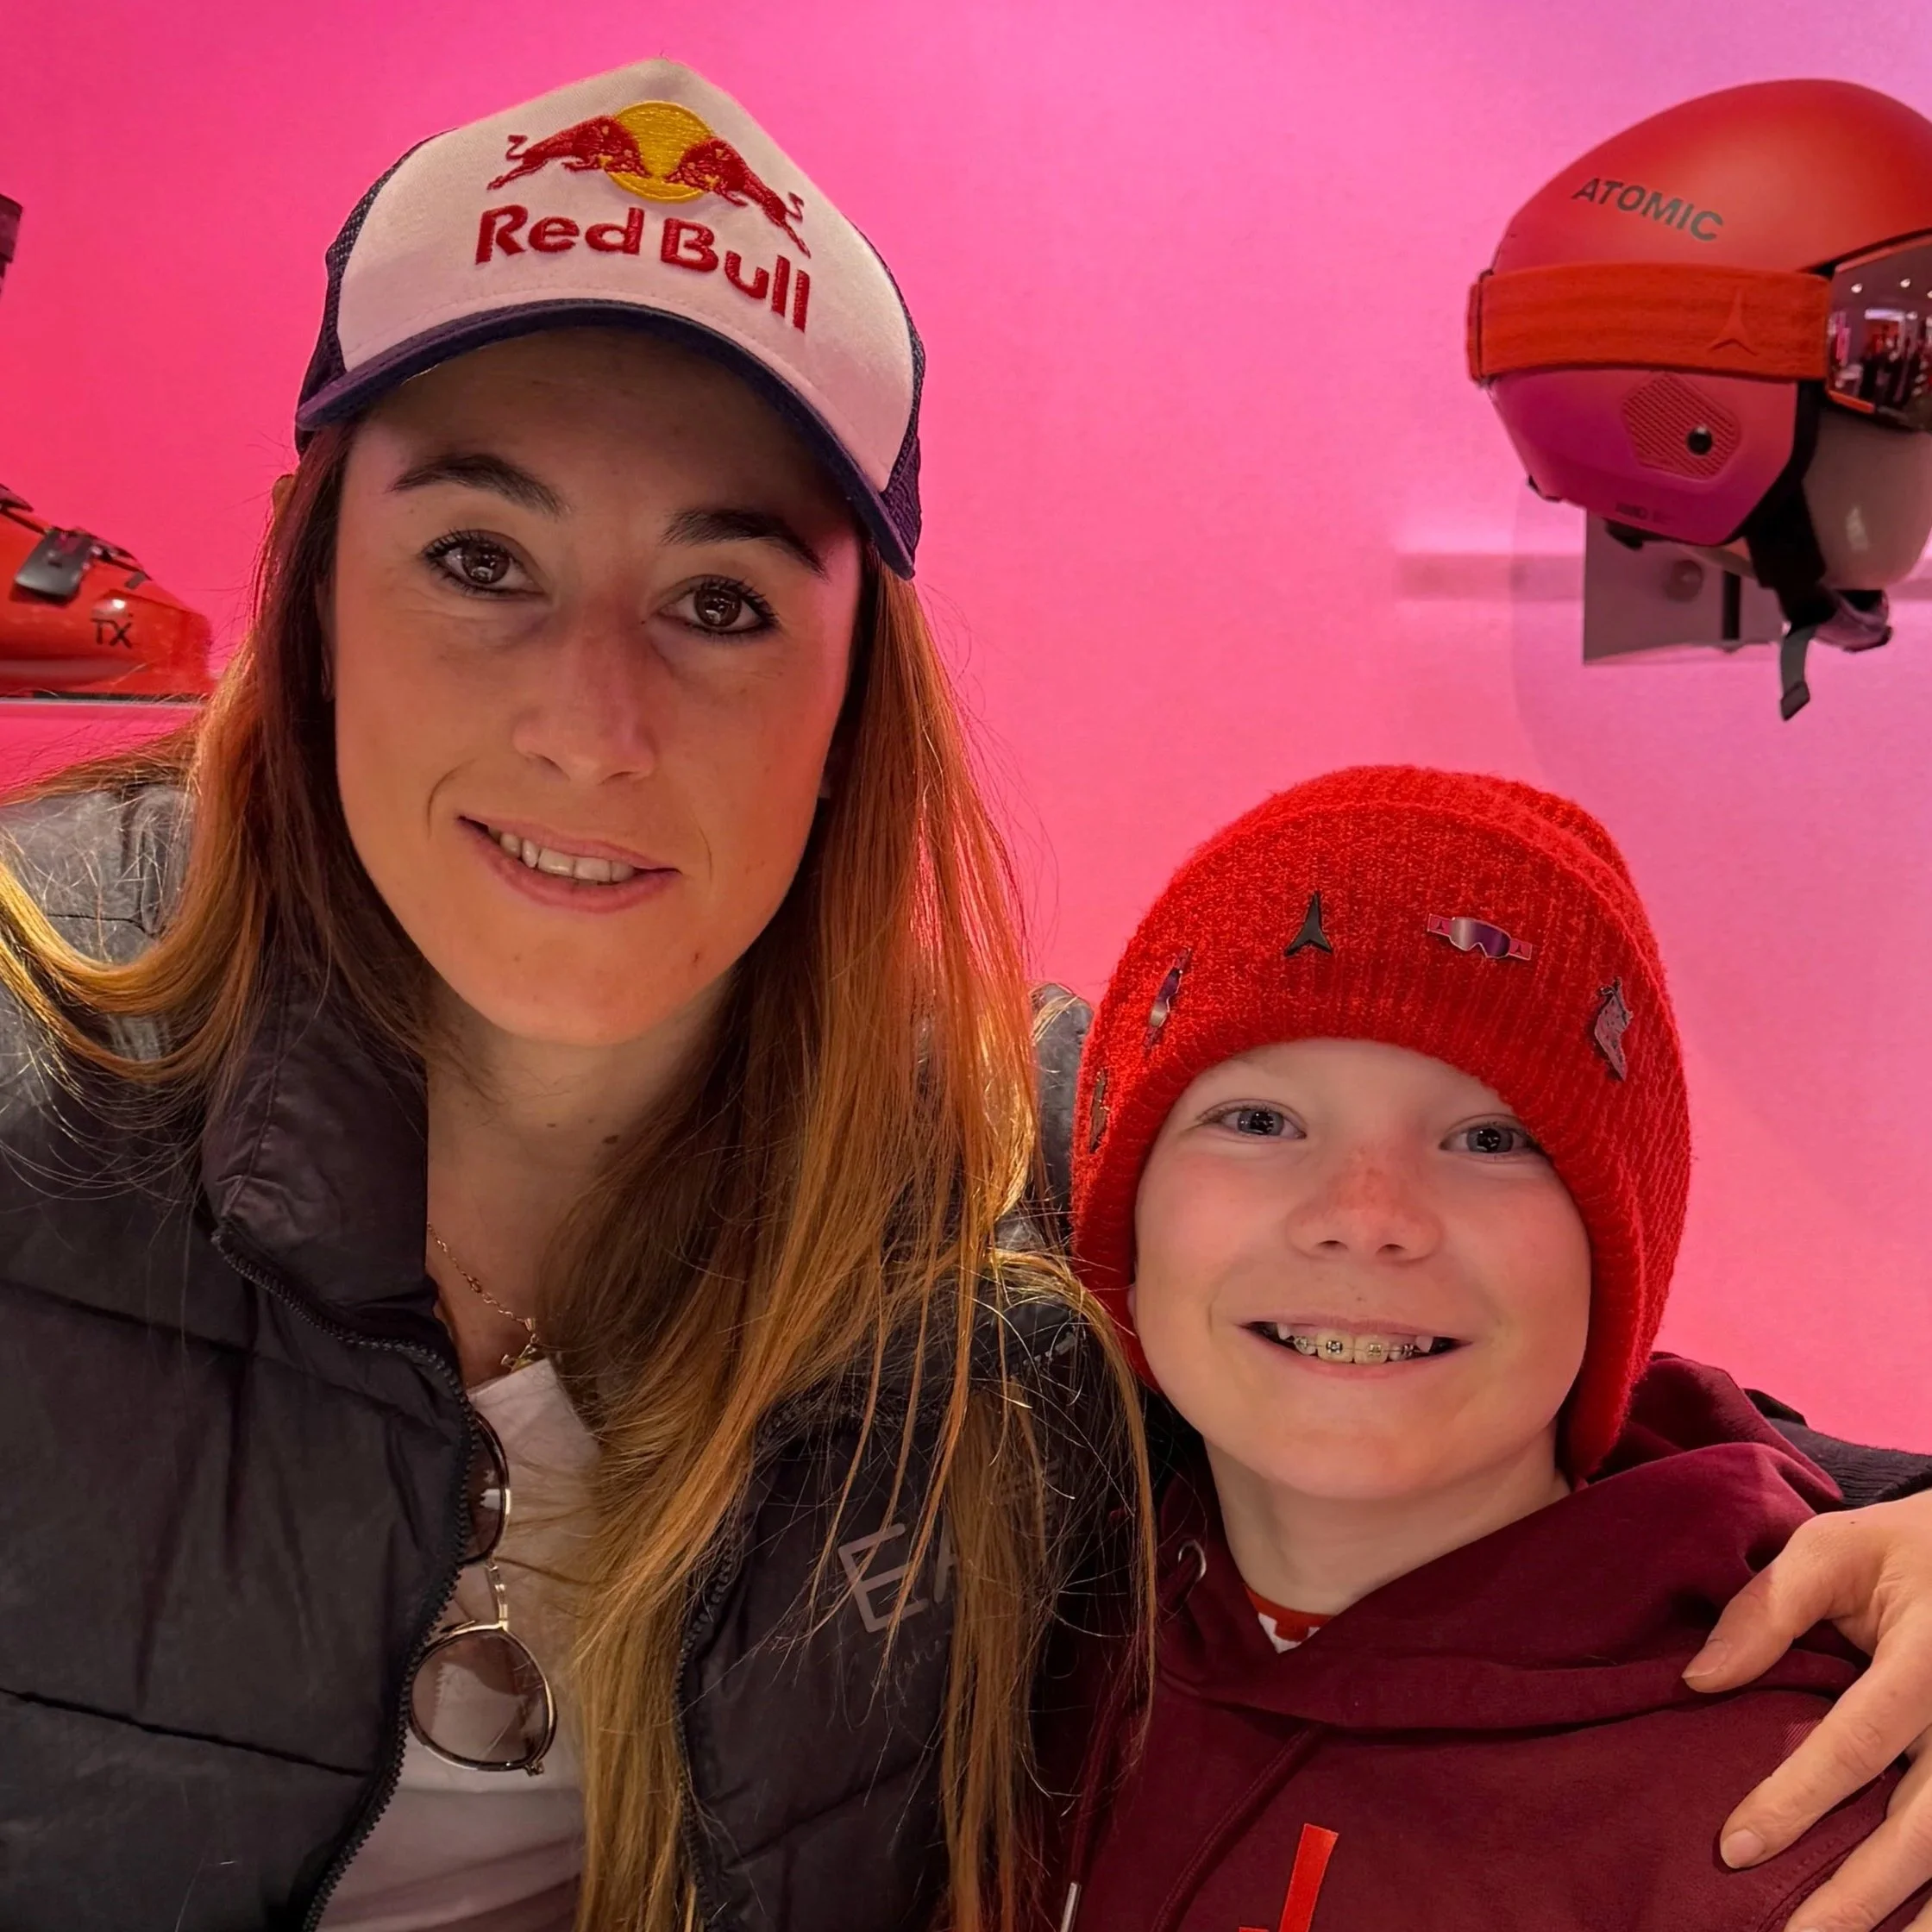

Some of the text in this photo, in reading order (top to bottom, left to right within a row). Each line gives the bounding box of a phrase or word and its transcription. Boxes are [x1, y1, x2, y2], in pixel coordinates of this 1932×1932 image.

[1571, 178, 1723, 242] ATOMIC
[475, 204, 811, 333] Red Bull
